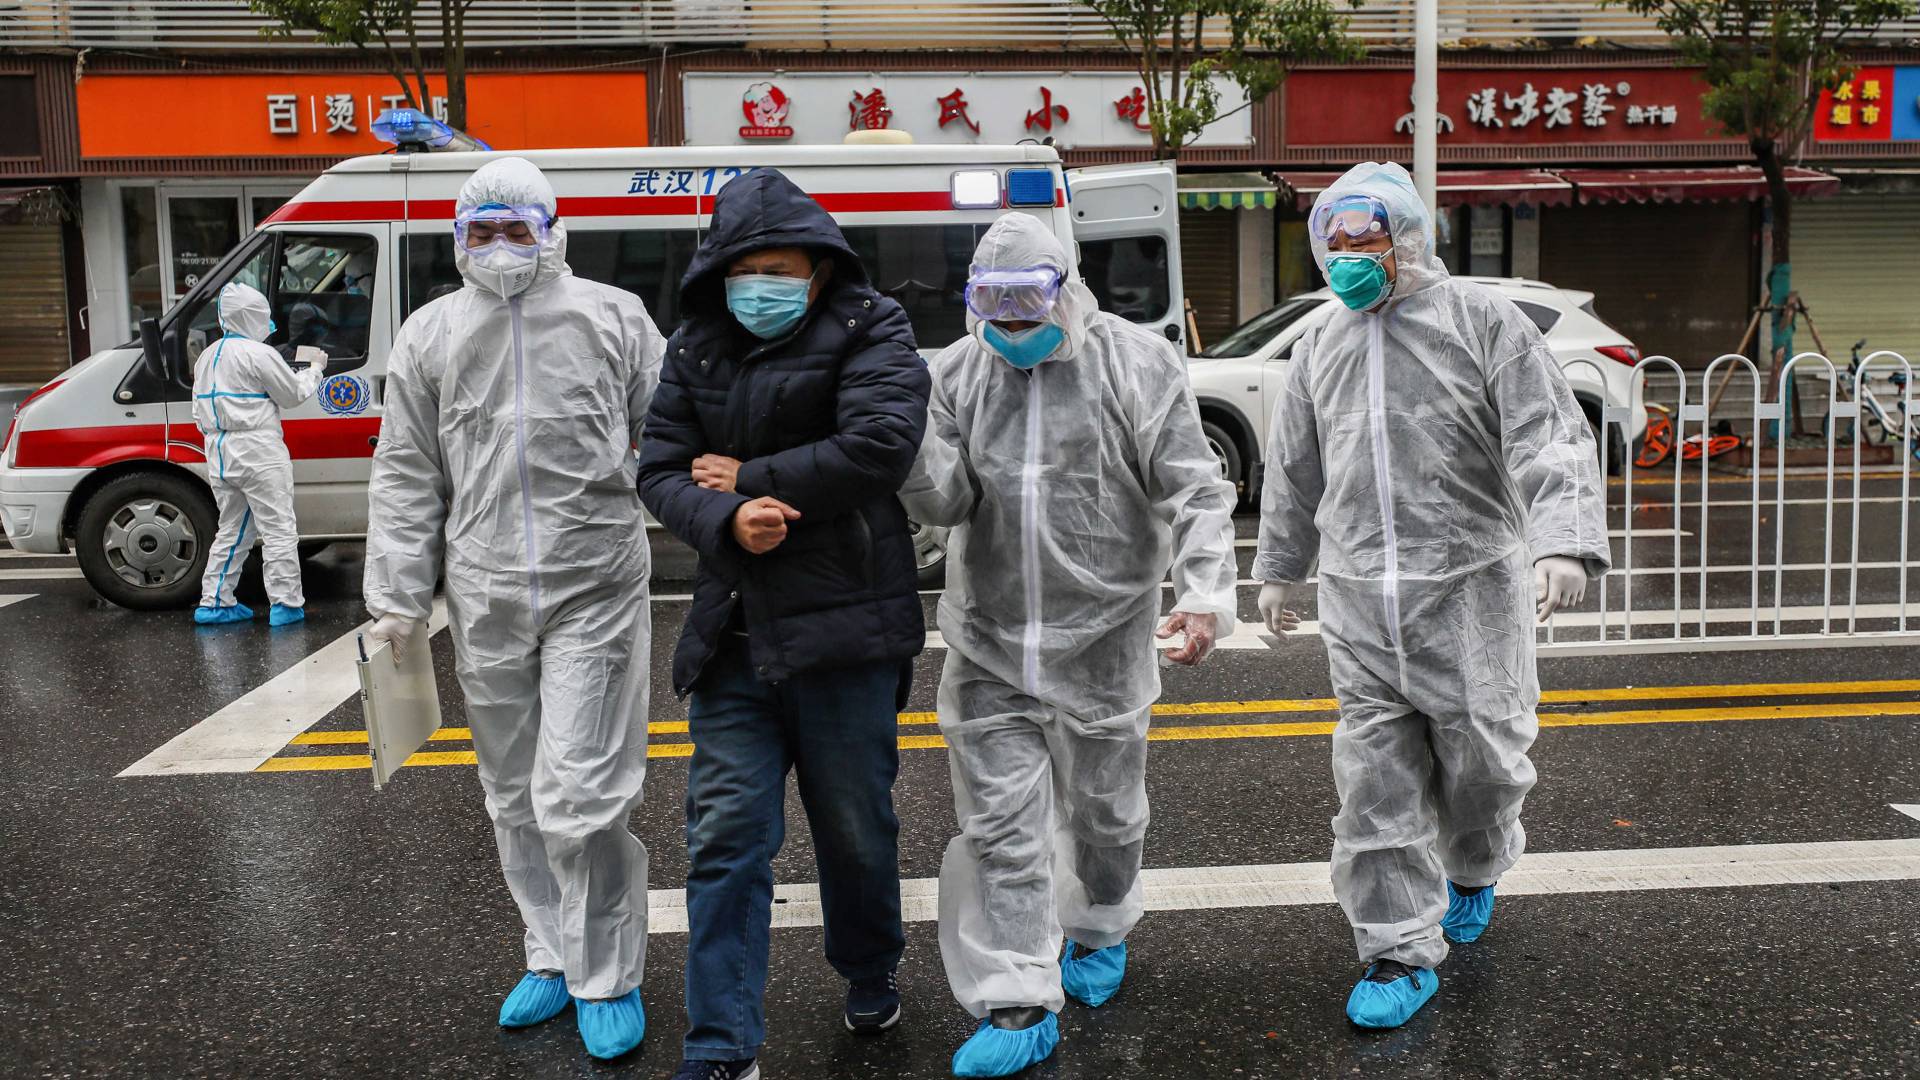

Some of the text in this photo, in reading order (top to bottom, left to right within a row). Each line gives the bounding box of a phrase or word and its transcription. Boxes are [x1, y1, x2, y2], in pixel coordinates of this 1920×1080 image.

[1832, 80, 1881, 100] 水果
[849, 86, 1150, 135] 潘氏小吃
[1830, 104, 1880, 125] 超市
[627, 169, 694, 195] 武汉
